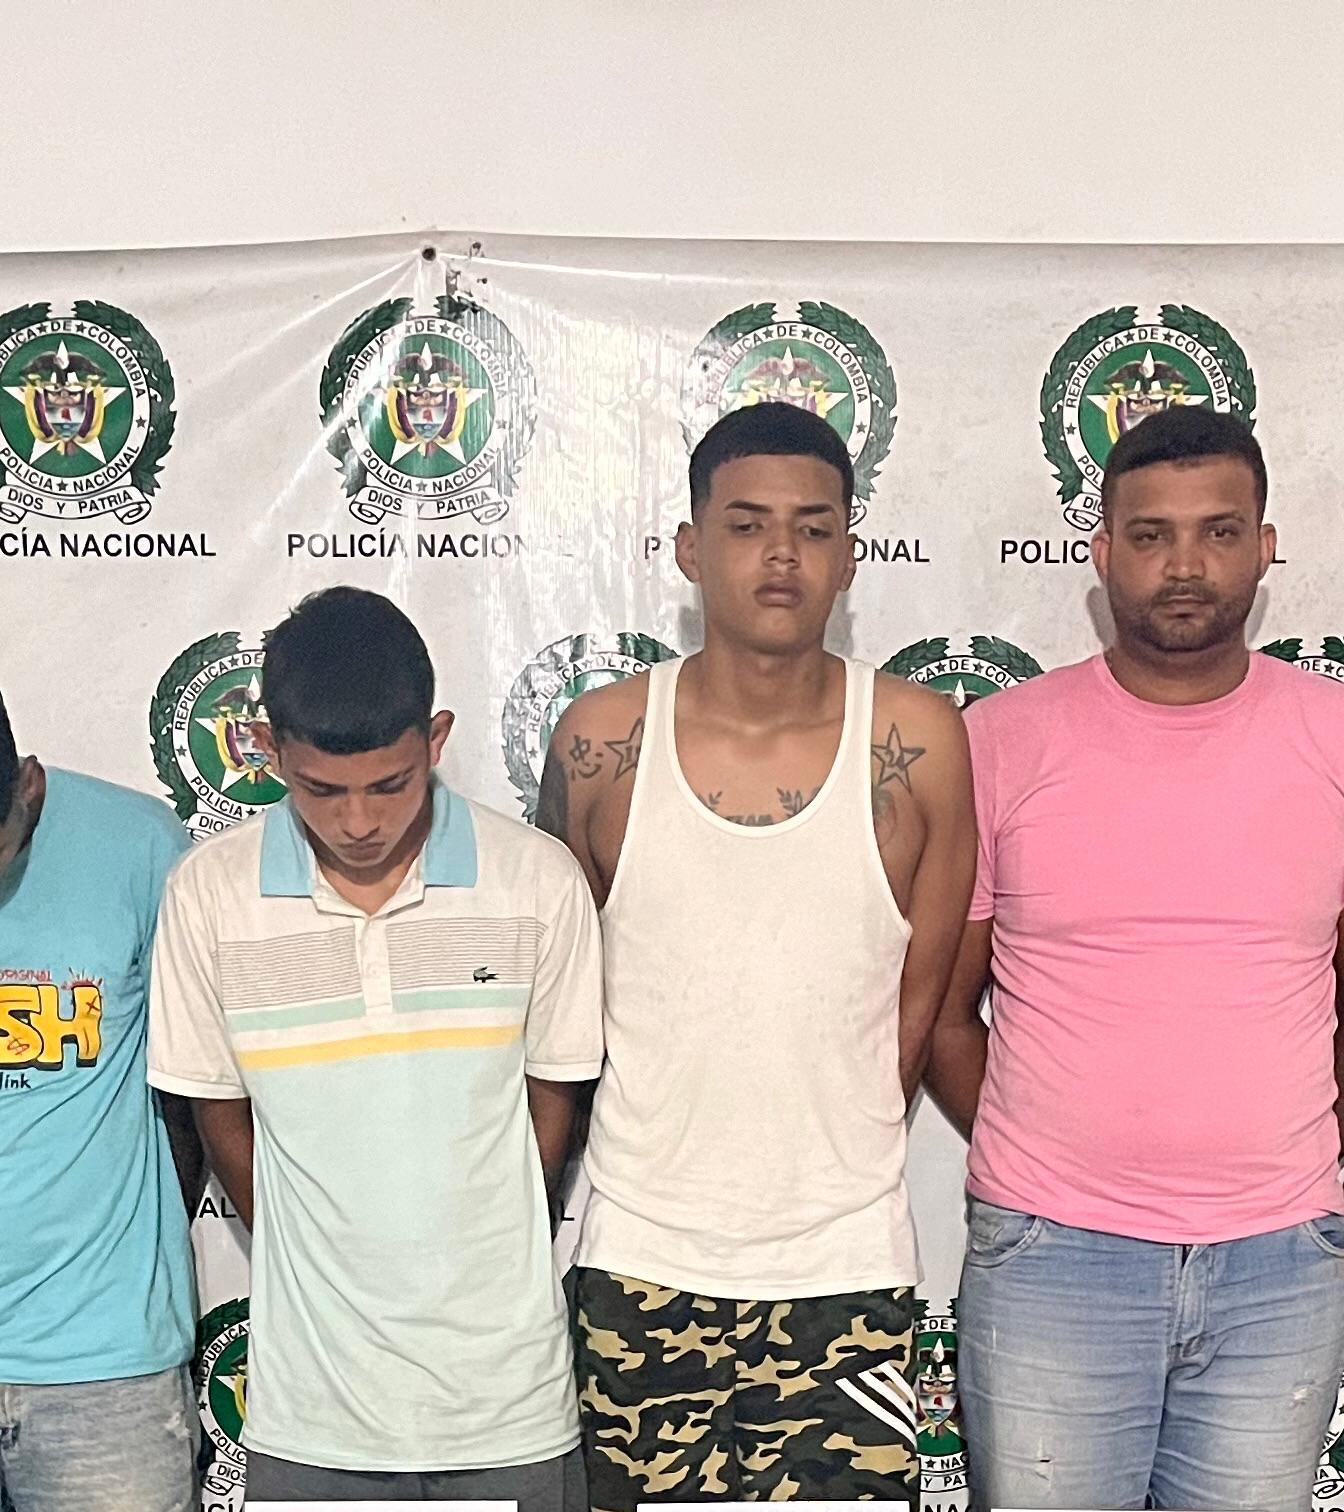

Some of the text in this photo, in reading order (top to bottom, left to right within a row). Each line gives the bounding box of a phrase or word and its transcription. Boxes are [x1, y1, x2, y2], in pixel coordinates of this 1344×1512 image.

[51, 321, 71, 331] DE
[88, 326, 146, 398] COLOMBIA
[814, 332, 868, 404] COLOMBIA
[1138, 330, 1159, 340] DE
[1175, 335, 1227, 406] COLOMBIA
[359, 448, 413, 491] POLICIA
[8, 489, 133, 512] DIOS PATRIA
[368, 490, 491, 513] DIOS PATRIA
[60, 534, 217, 556] NACIONAL
[1001, 540, 1089, 564] POLIC
[190, 776, 243, 817] POLICIA
